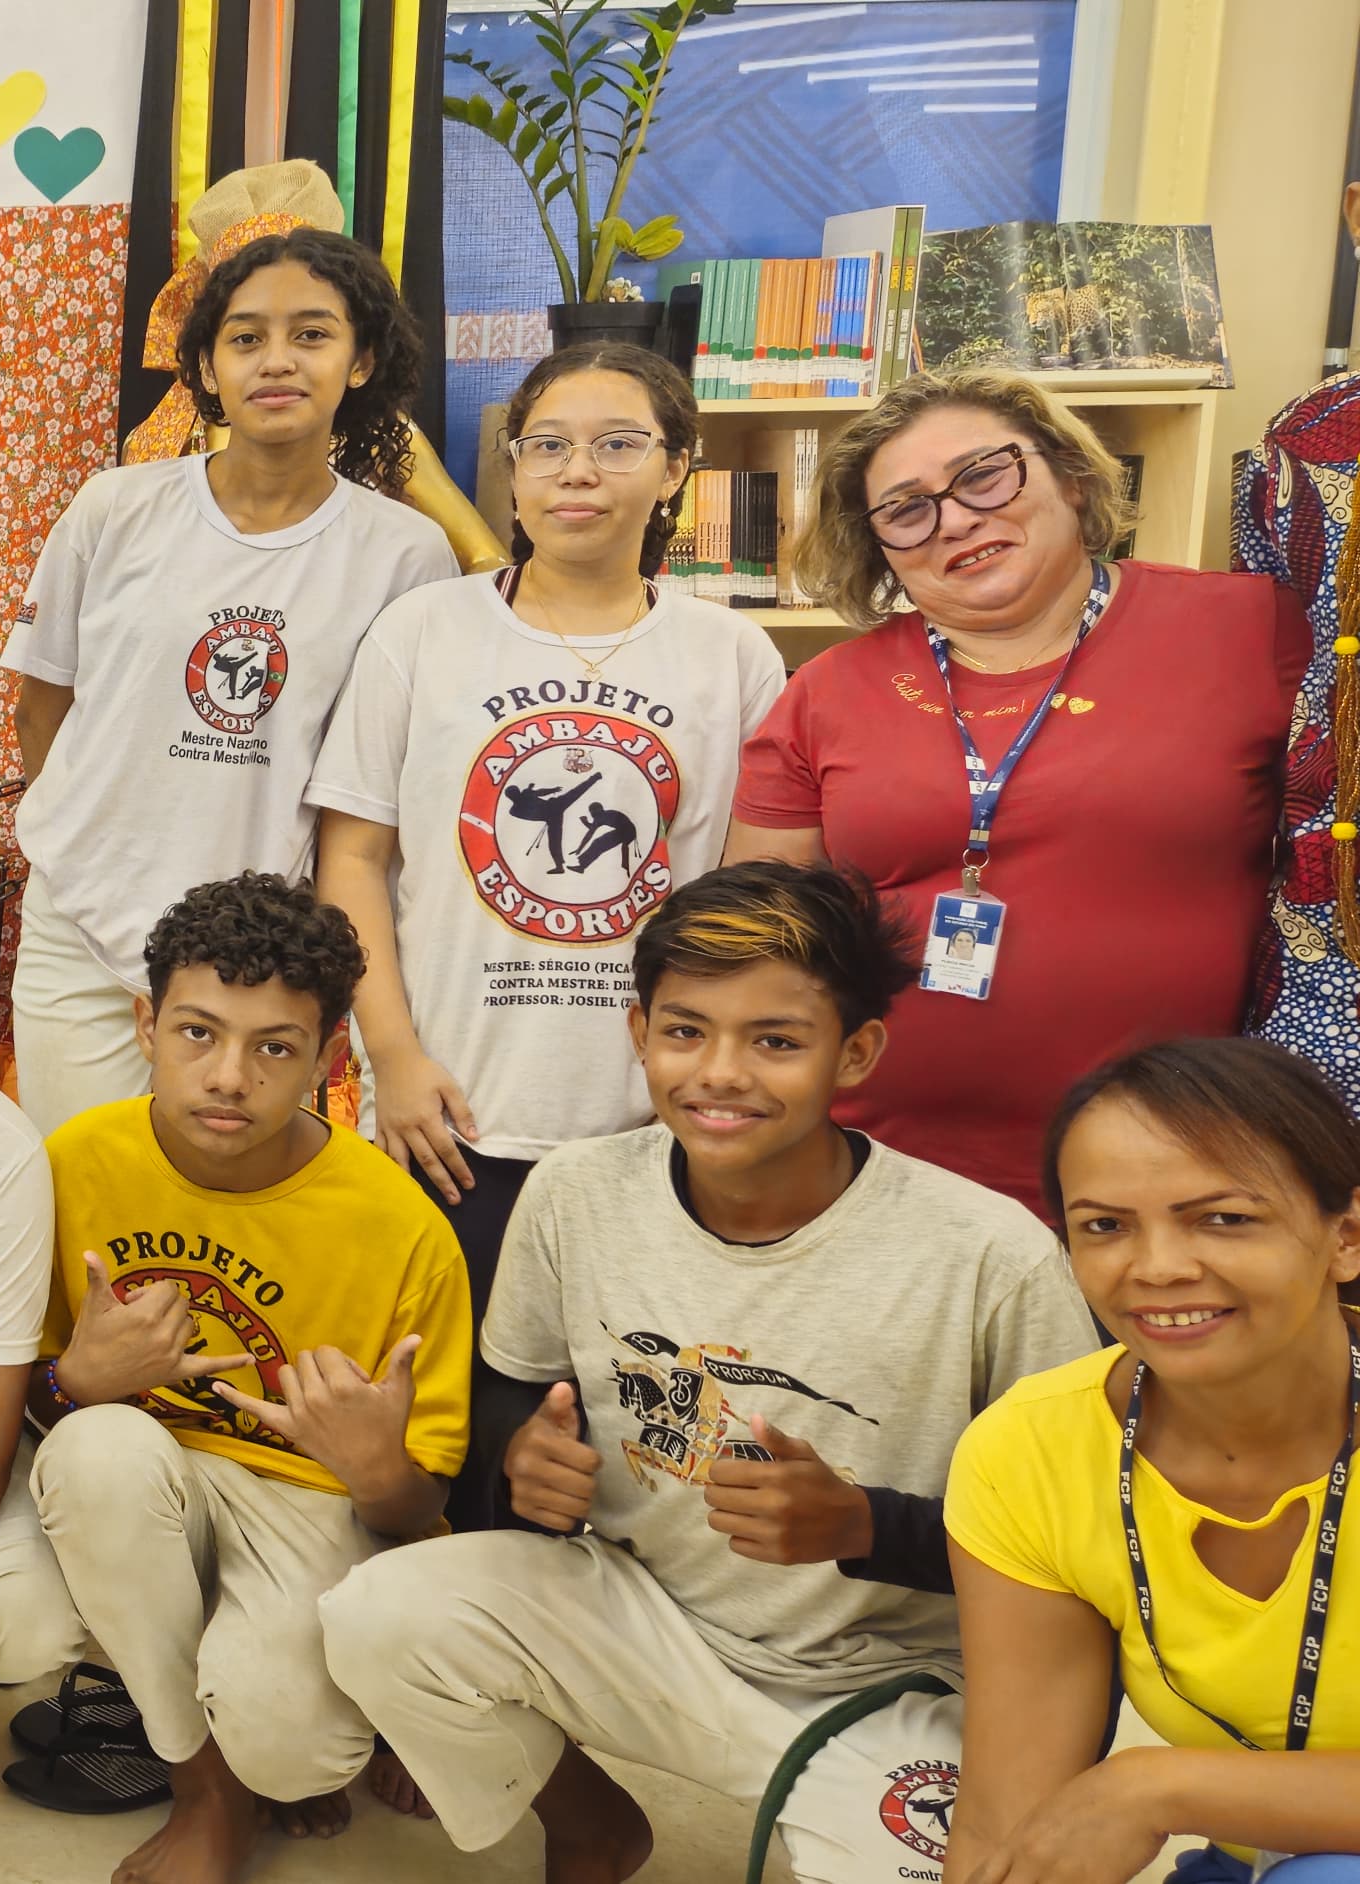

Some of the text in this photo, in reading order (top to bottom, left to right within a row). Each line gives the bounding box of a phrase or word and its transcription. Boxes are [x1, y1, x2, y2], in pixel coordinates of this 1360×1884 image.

[482, 679, 675, 729] PROJETO
[168, 744, 250, 766] Contra Mestr
[181, 730, 223, 747] Mestre
[484, 718, 673, 785] AMBAJU
[477, 860, 672, 937] ESPORTES
[483, 958, 633, 974] MESTRE: SÉRGIO (PICA-
[483, 994, 564, 1007] PROFESSOR:
[567, 995, 617, 1008] JOSIEL
[489, 978, 635, 991] CONTRA MESTRE: DIL
[106, 1230, 285, 1308] PROJETO
[706, 1359, 793, 1388] PRORSUM
[1123, 1418, 1137, 1450] FCP
[1120, 1471, 1131, 1505] FCP
[1330, 1461, 1348, 1497] FCP
[1127, 1528, 1140, 1562] FCP
[1319, 1519, 1337, 1555] FCP
[1138, 1586, 1150, 1620] FCP
[1311, 1577, 1329, 1614] FCP
[1302, 1636, 1321, 1672] FCP
[1293, 1694, 1312, 1728] FCP
[884, 1759, 959, 1782] PROJE
[892, 1772, 959, 1801] AMBA
[898, 1866, 943, 1883] Contr
